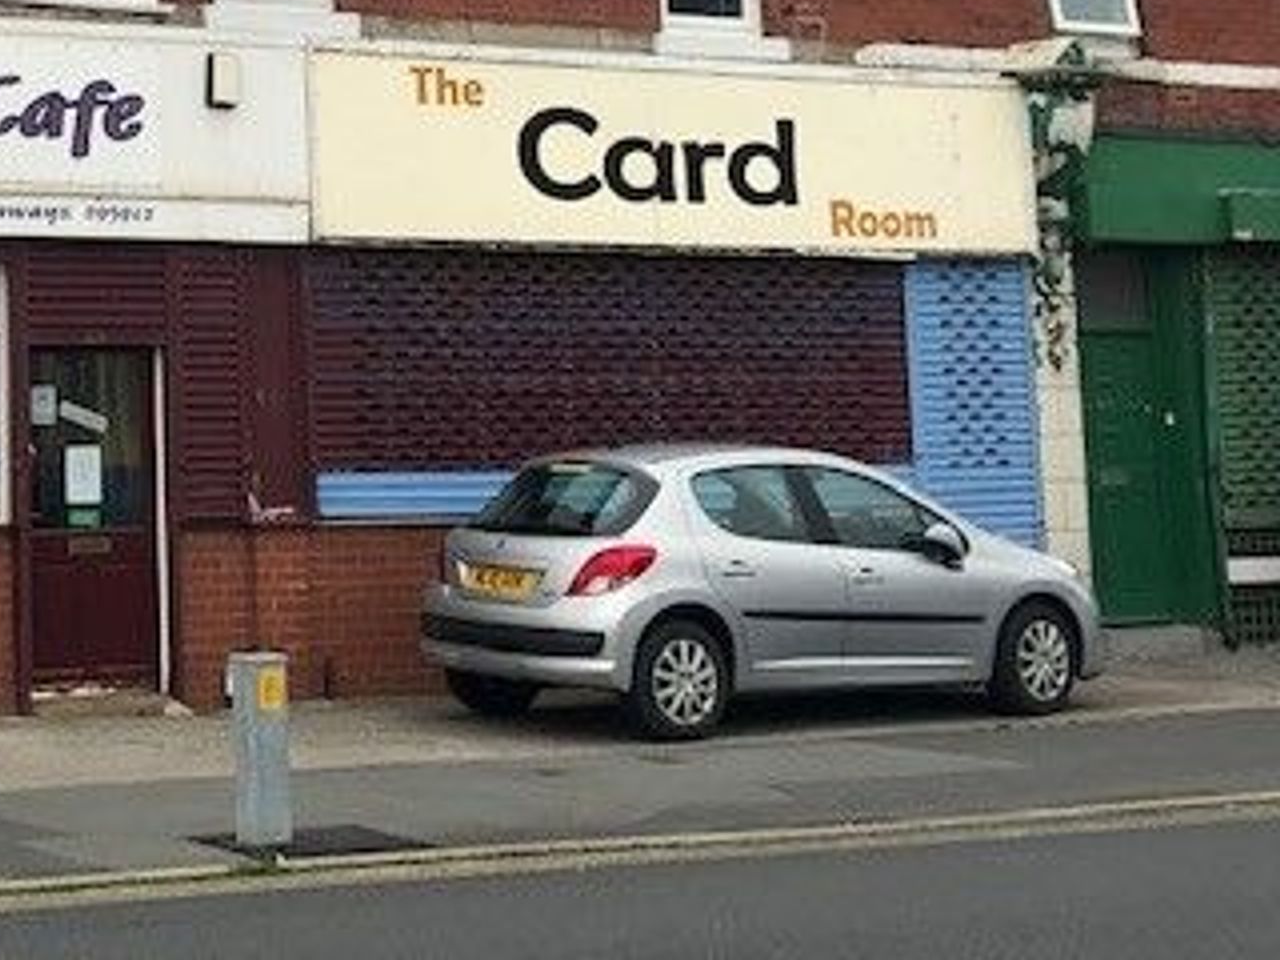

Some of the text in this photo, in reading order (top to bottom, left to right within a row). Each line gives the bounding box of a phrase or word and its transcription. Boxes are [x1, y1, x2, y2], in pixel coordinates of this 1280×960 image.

[409, 67, 484, 106] The
[517, 106, 800, 207] Card
[830, 200, 939, 239] Room
